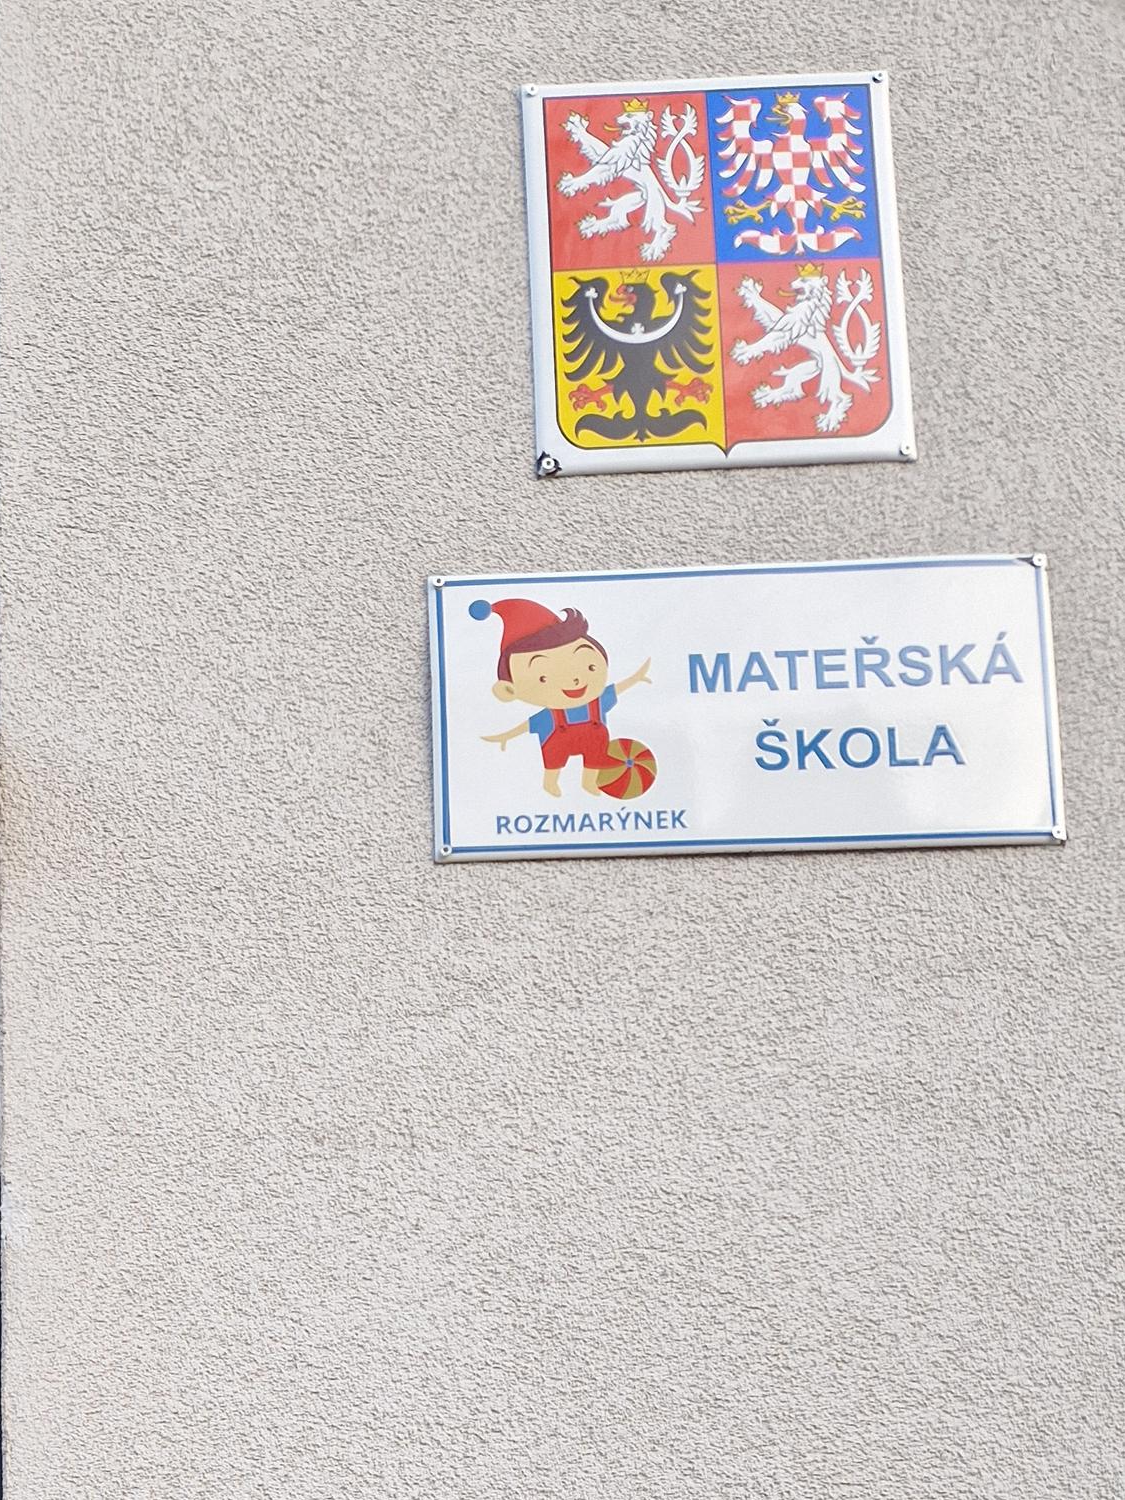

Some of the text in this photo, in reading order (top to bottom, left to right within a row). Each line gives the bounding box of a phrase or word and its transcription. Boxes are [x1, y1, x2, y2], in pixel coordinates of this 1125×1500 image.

[688, 633, 1023, 694] MATEŘSKÁ
[754, 718, 965, 772] ŠKOLA
[495, 807, 688, 835] ROZMARÝNEK
